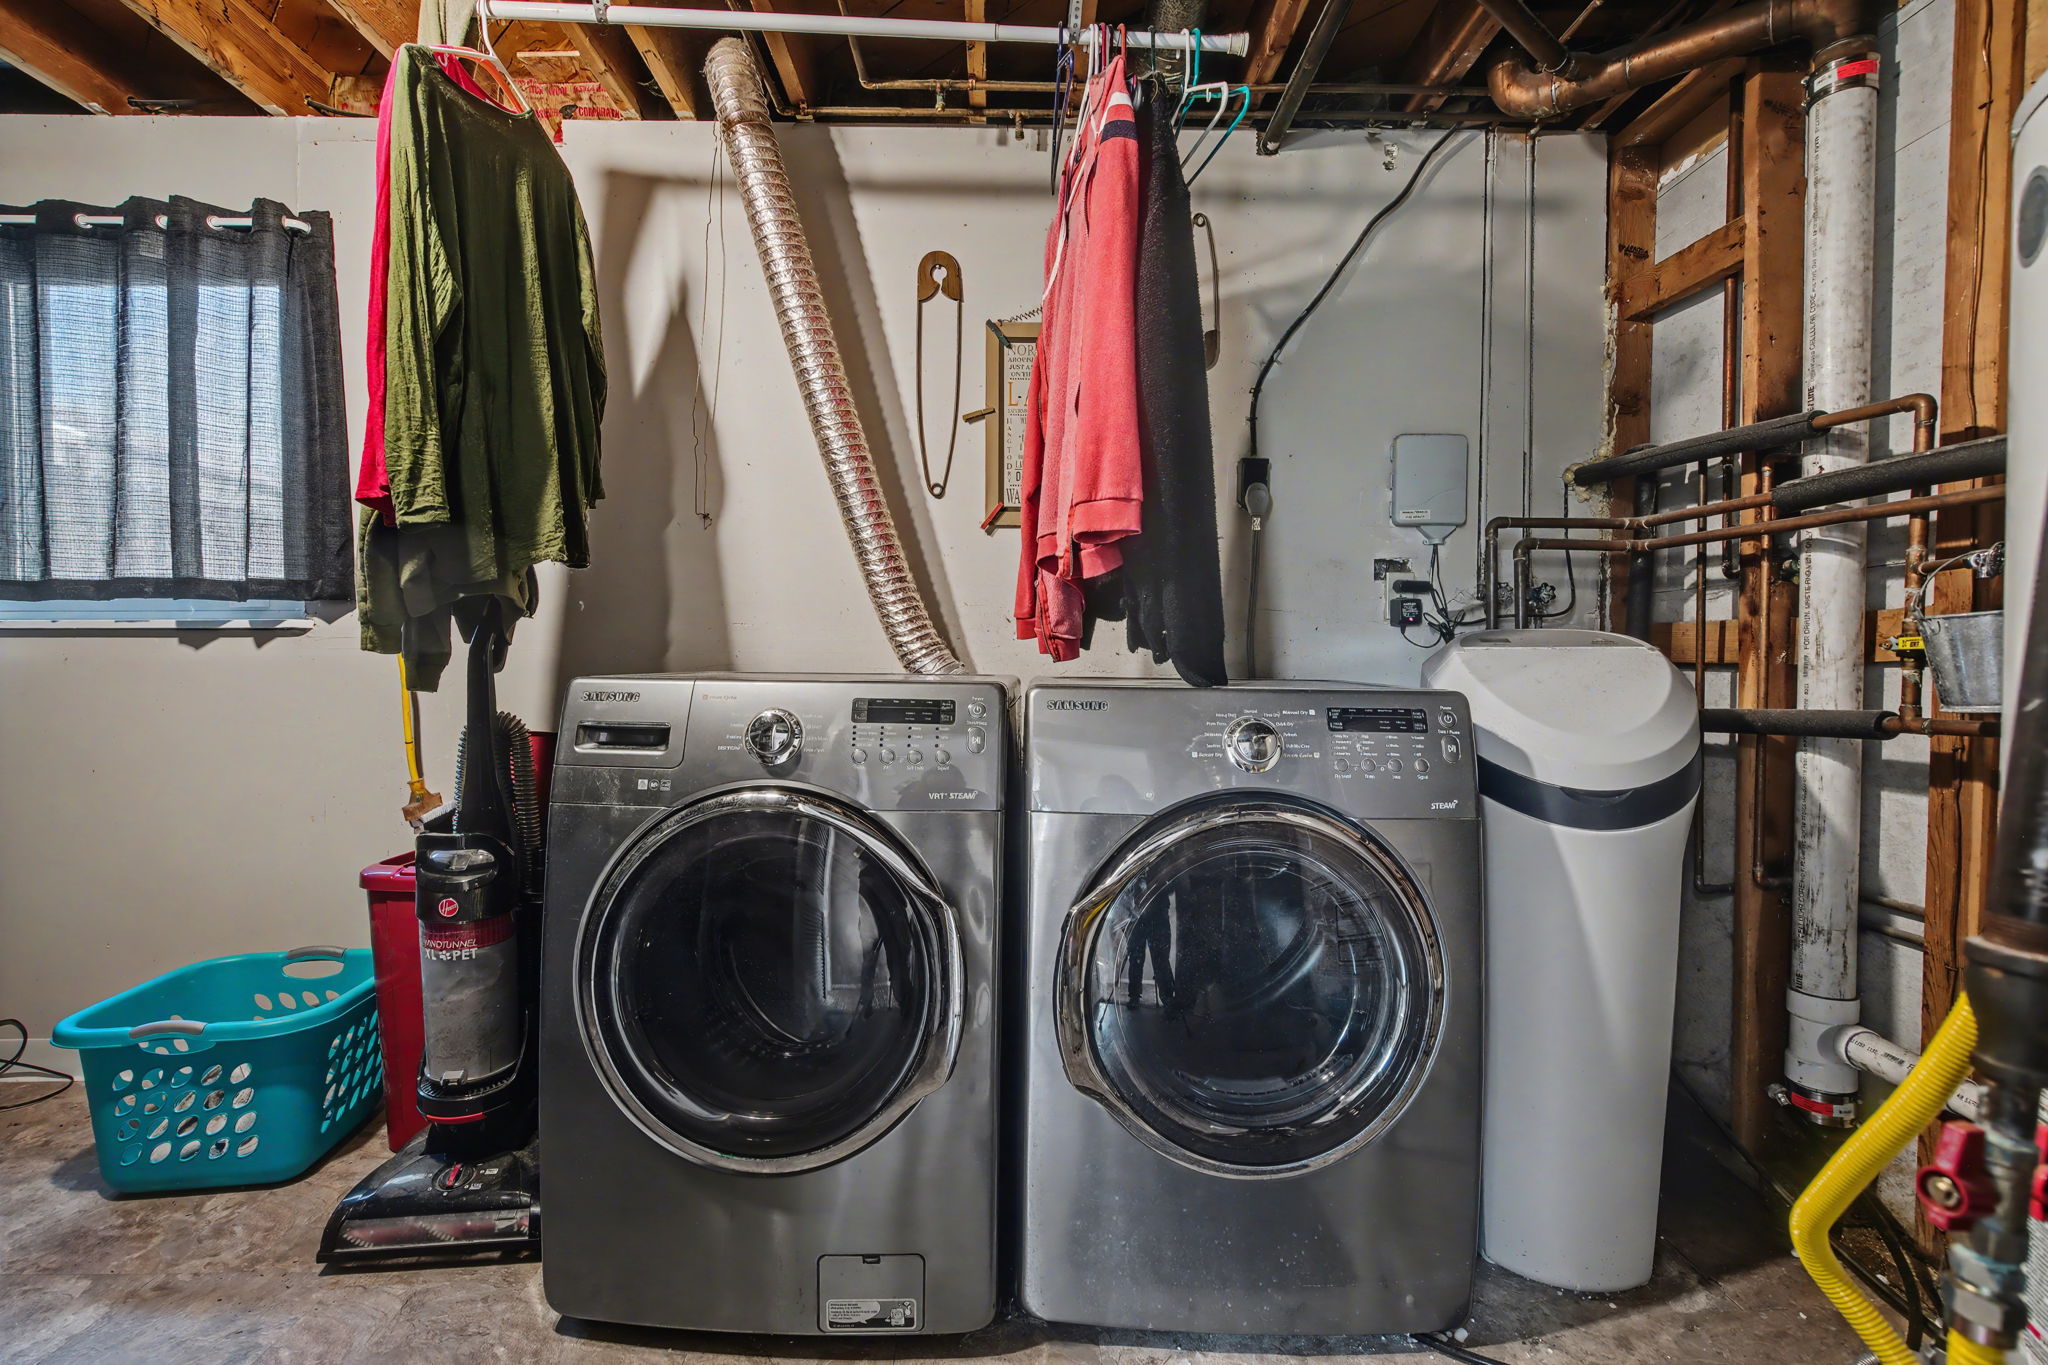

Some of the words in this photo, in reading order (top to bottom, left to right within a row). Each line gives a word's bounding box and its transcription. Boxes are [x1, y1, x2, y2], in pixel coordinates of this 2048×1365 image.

[582, 691, 641, 702] SAMSUNG
[1047, 699, 1109, 711] SAMSUNG
[1430, 799, 1458, 810] STEAM
[453, 948, 478, 961] PET
